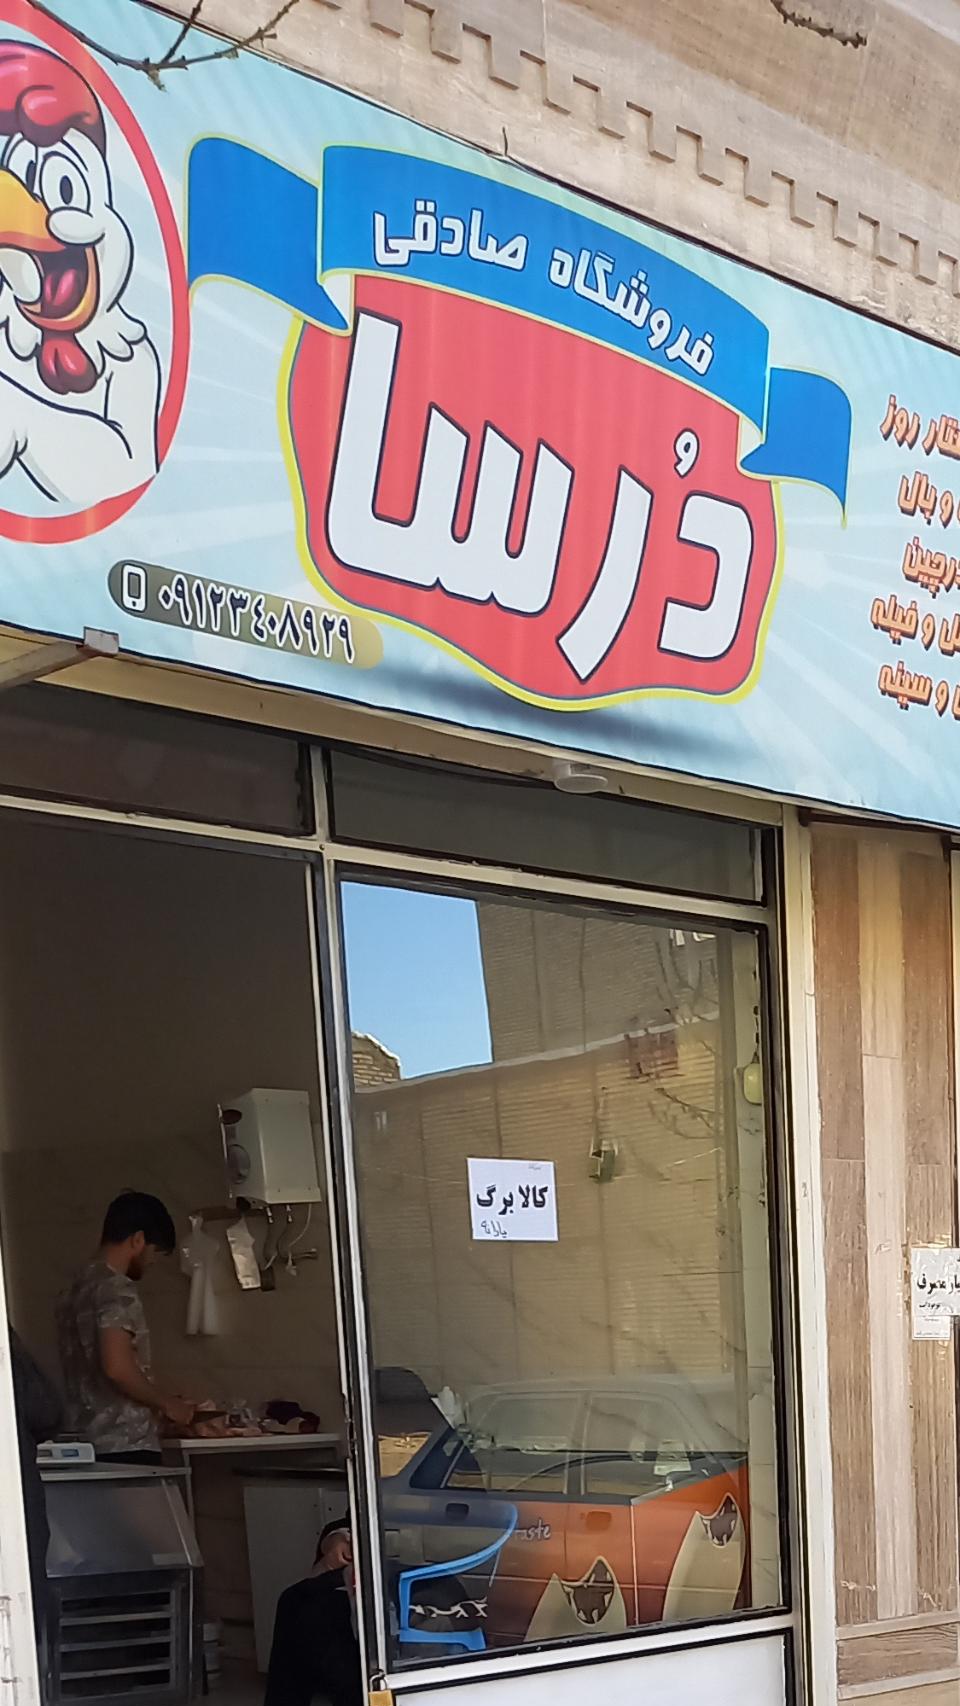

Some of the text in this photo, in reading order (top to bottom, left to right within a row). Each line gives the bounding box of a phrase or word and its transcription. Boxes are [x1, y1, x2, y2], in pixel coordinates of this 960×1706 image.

[372, 198, 715, 376] فروشگاه صادقی
[880, 394, 921, 450] روز
[898, 471, 938, 525] بال
[939, 490, 955, 528] و
[871, 595, 919, 645] فیله
[921, 613, 936, 651] و
[878, 661, 932, 711] سینه
[935, 680, 950, 717] و
